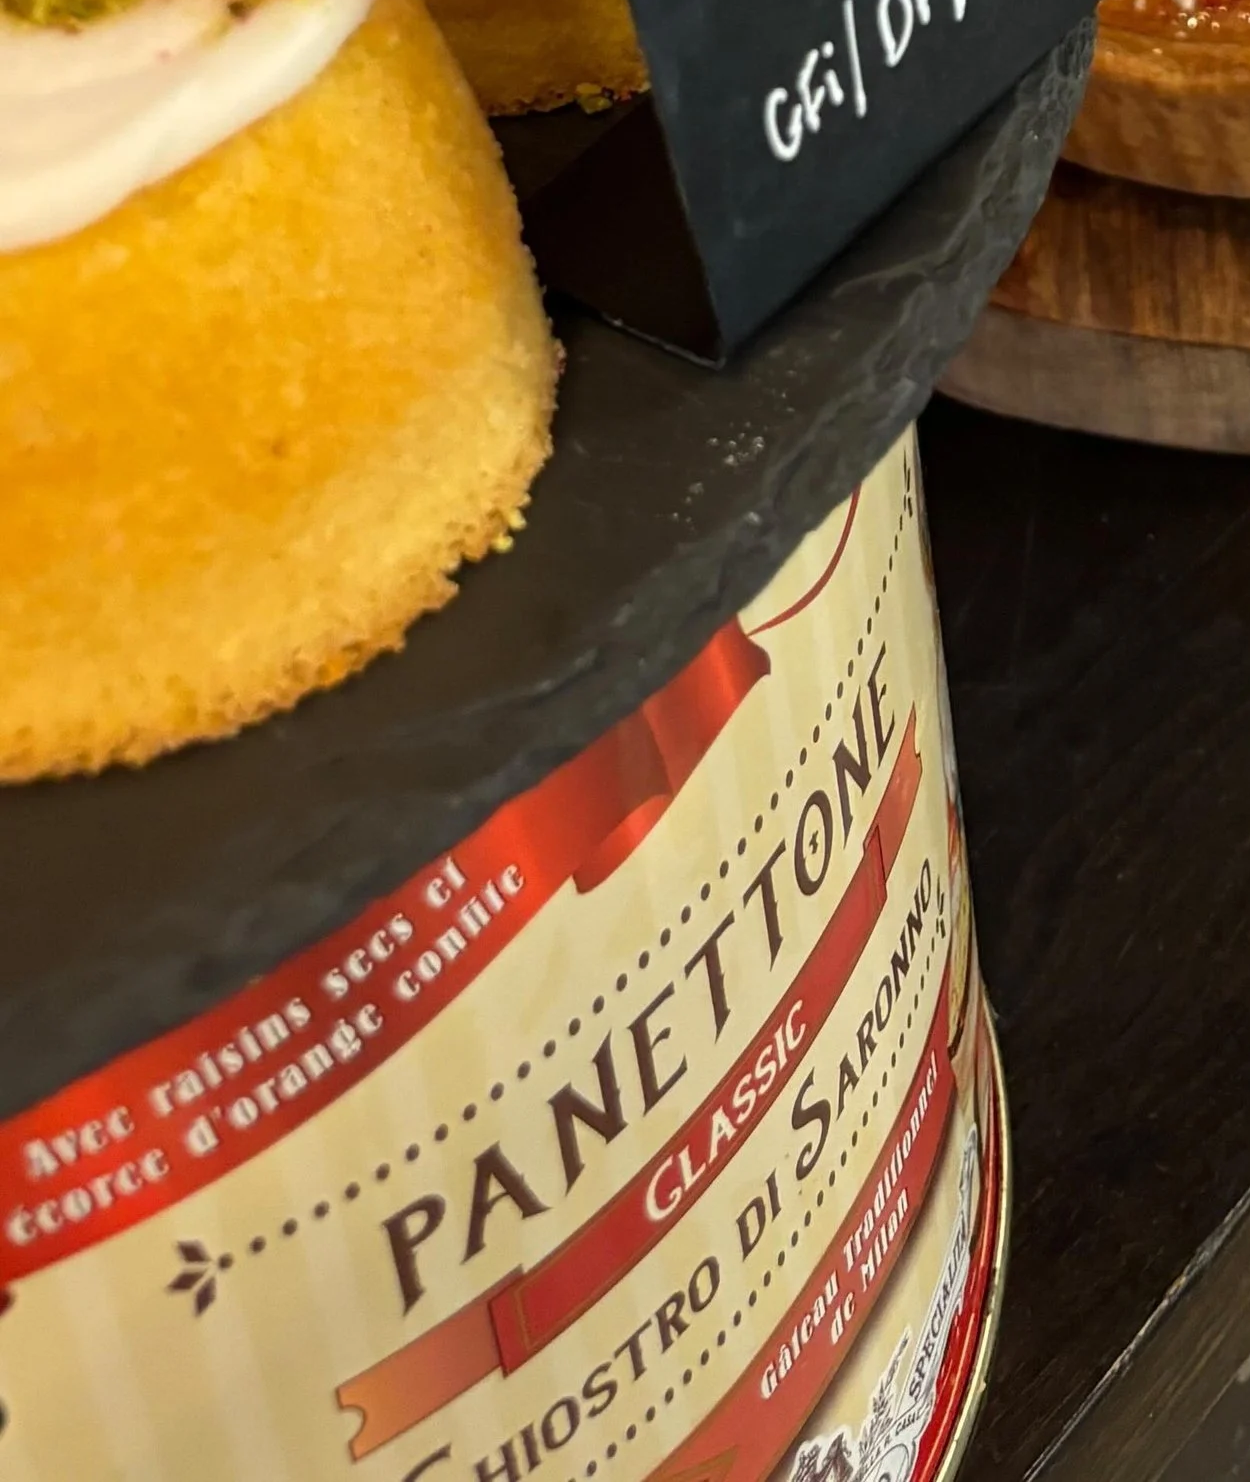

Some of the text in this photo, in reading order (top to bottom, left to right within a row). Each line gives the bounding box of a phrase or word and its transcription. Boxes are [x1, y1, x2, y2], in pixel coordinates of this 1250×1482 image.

[6, 862, 526, 1246] écorce d'orange confite
[21, 854, 468, 1181] Avec raisins secs et
[381, 642, 895, 1317] PANETTONE
[644, 999, 809, 1222] CLASSIC
[736, 1168, 782, 1263] DI
[791, 858, 932, 1182] SARONNO
[760, 1050, 938, 1400] Gâteau Traditionnel
[830, 1187, 909, 1346] de Milan
